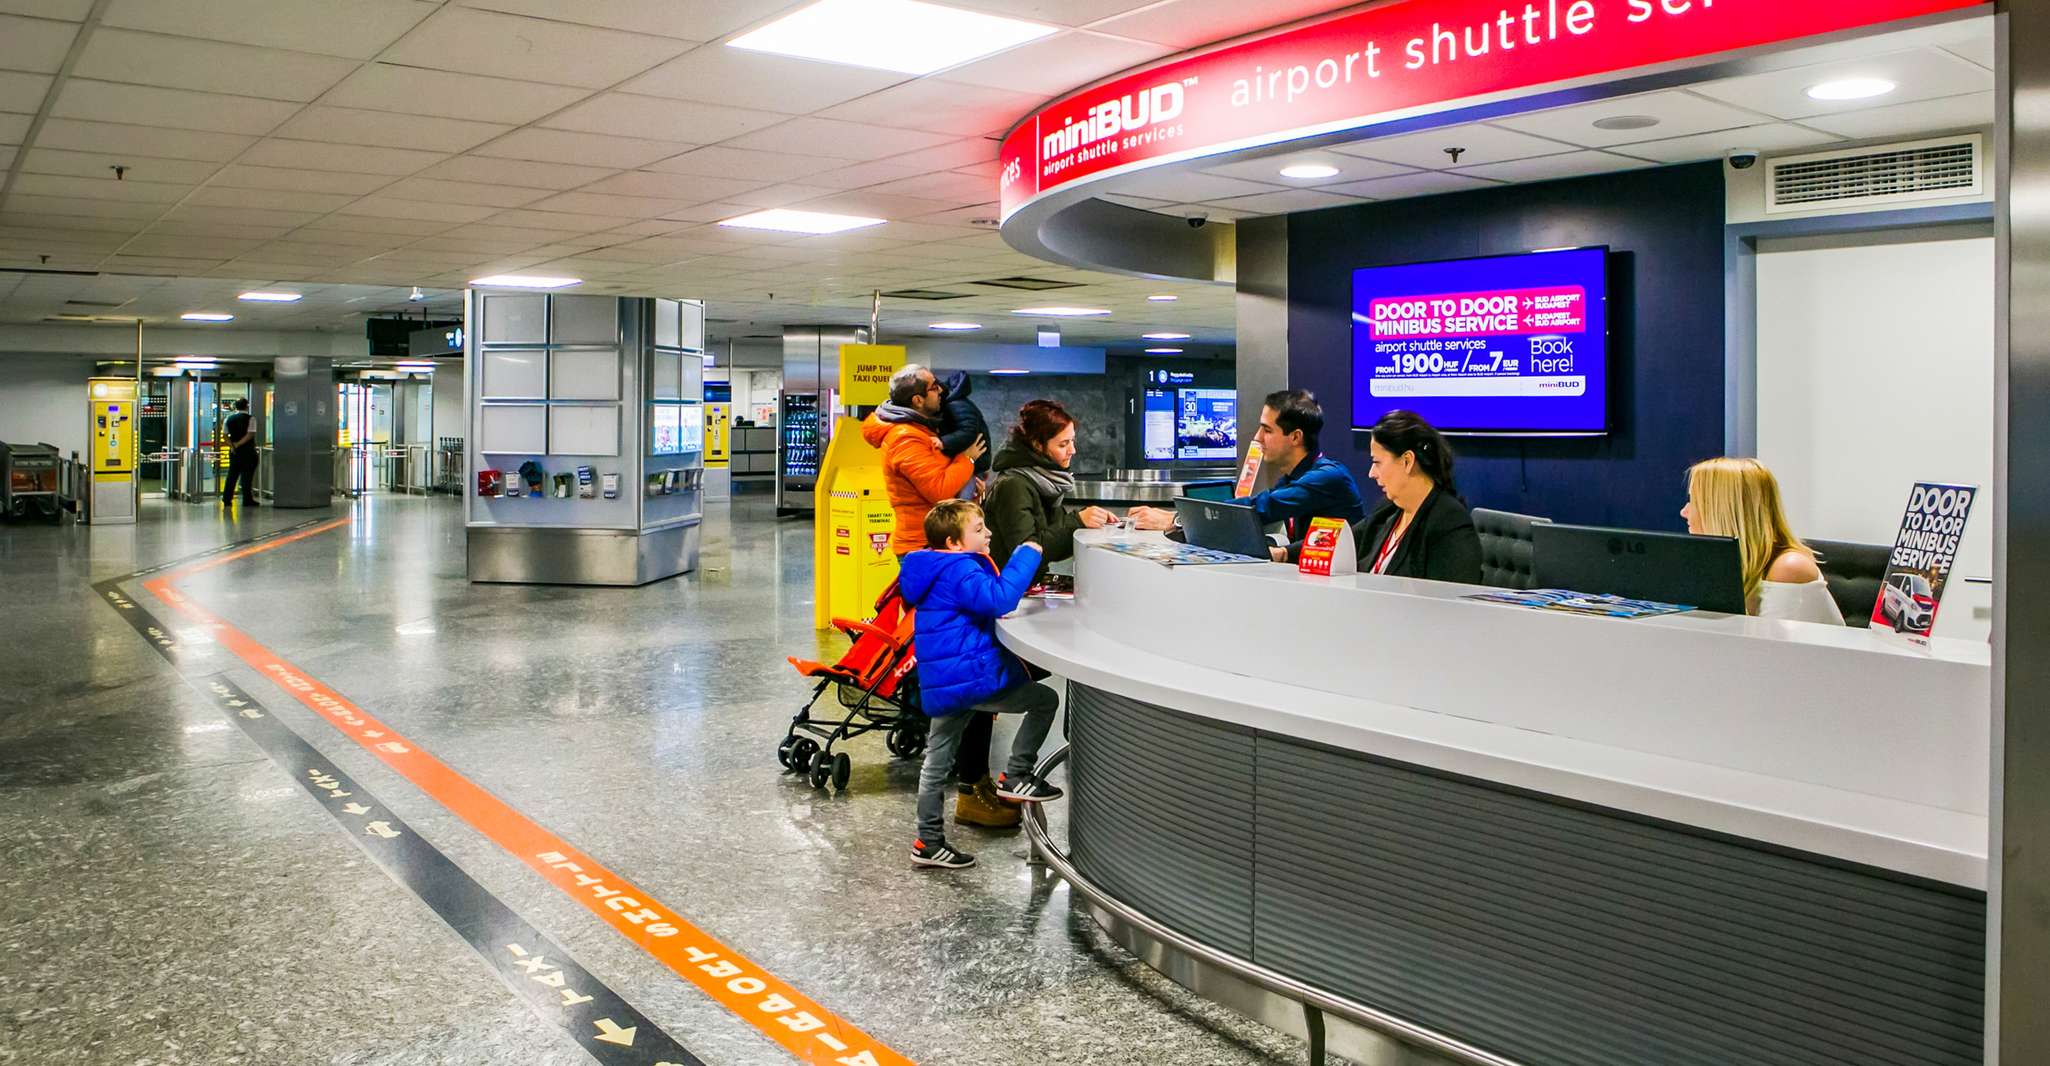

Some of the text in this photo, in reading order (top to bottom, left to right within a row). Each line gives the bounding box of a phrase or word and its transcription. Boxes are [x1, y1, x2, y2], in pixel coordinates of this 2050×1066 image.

[1230, 0, 1596, 107] airport shuttle
[1043, 81, 1184, 160] miniBUD
[1043, 123, 1184, 177] airport shuttle services
[1375, 296, 1517, 320] DOOR TO DOOR
[1375, 314, 1518, 336] MINIBUS SERVICE
[1375, 338, 1486, 354] airport shuttle services
[1530, 338, 1573, 355] Book
[856, 365, 878, 374] JUMP
[1375, 366, 1394, 374] FROM
[1392, 353, 1444, 373] 1900
[1443, 360, 1459, 368] HUF
[1468, 364, 1490, 372] FROM
[1489, 351, 1503, 372] 7
[1503, 359, 1519, 367] EUR
[1530, 354, 1574, 373] here!
[1908, 487, 1971, 518] DOOR
[1906, 512, 1964, 536] TO DOOR
[1897, 528, 1958, 555] MINIBUS
[1891, 547, 1953, 574] SERVICE
[535, 851, 880, 1066] AIRPORT SHUTTLE
[505, 943, 594, 1007] TAXI
